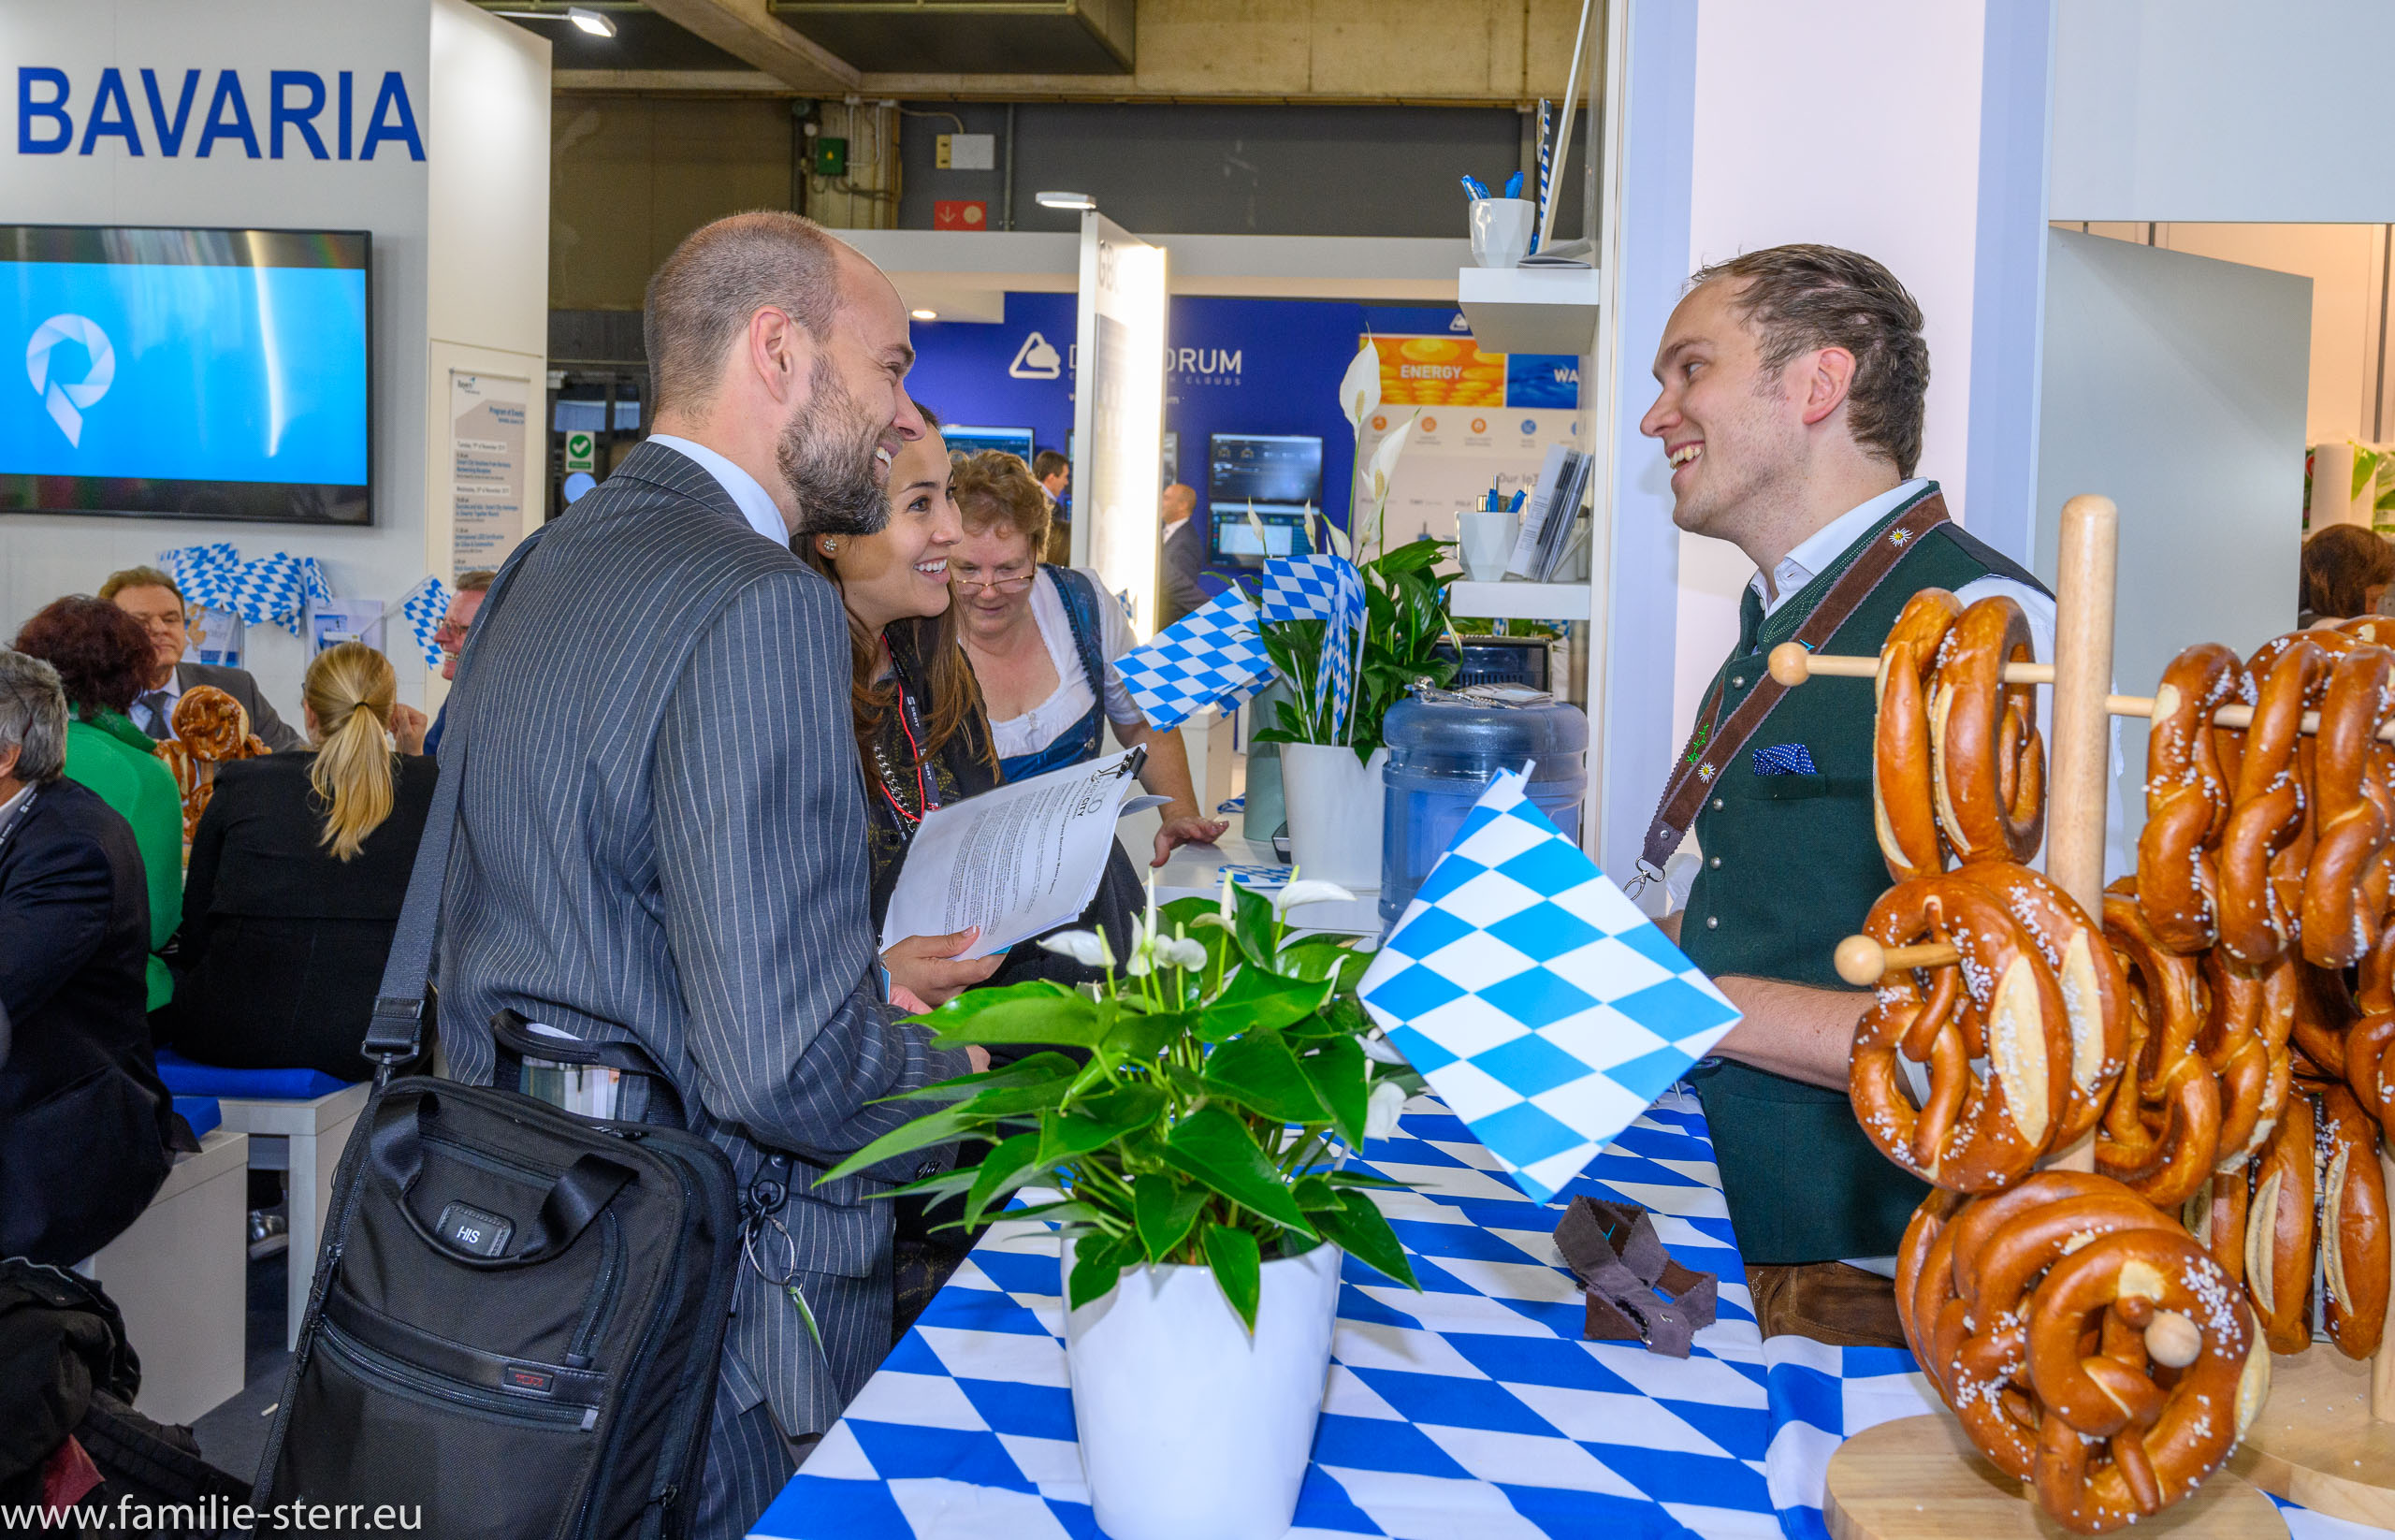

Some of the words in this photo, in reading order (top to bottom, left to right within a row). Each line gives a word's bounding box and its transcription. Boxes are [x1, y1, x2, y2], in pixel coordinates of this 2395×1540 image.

[18, 66, 427, 162] BAVARIA
[1401, 364, 1462, 380] ENERGY
[910, 705, 920, 728] SEAT
[456, 1225, 481, 1244] HIS
